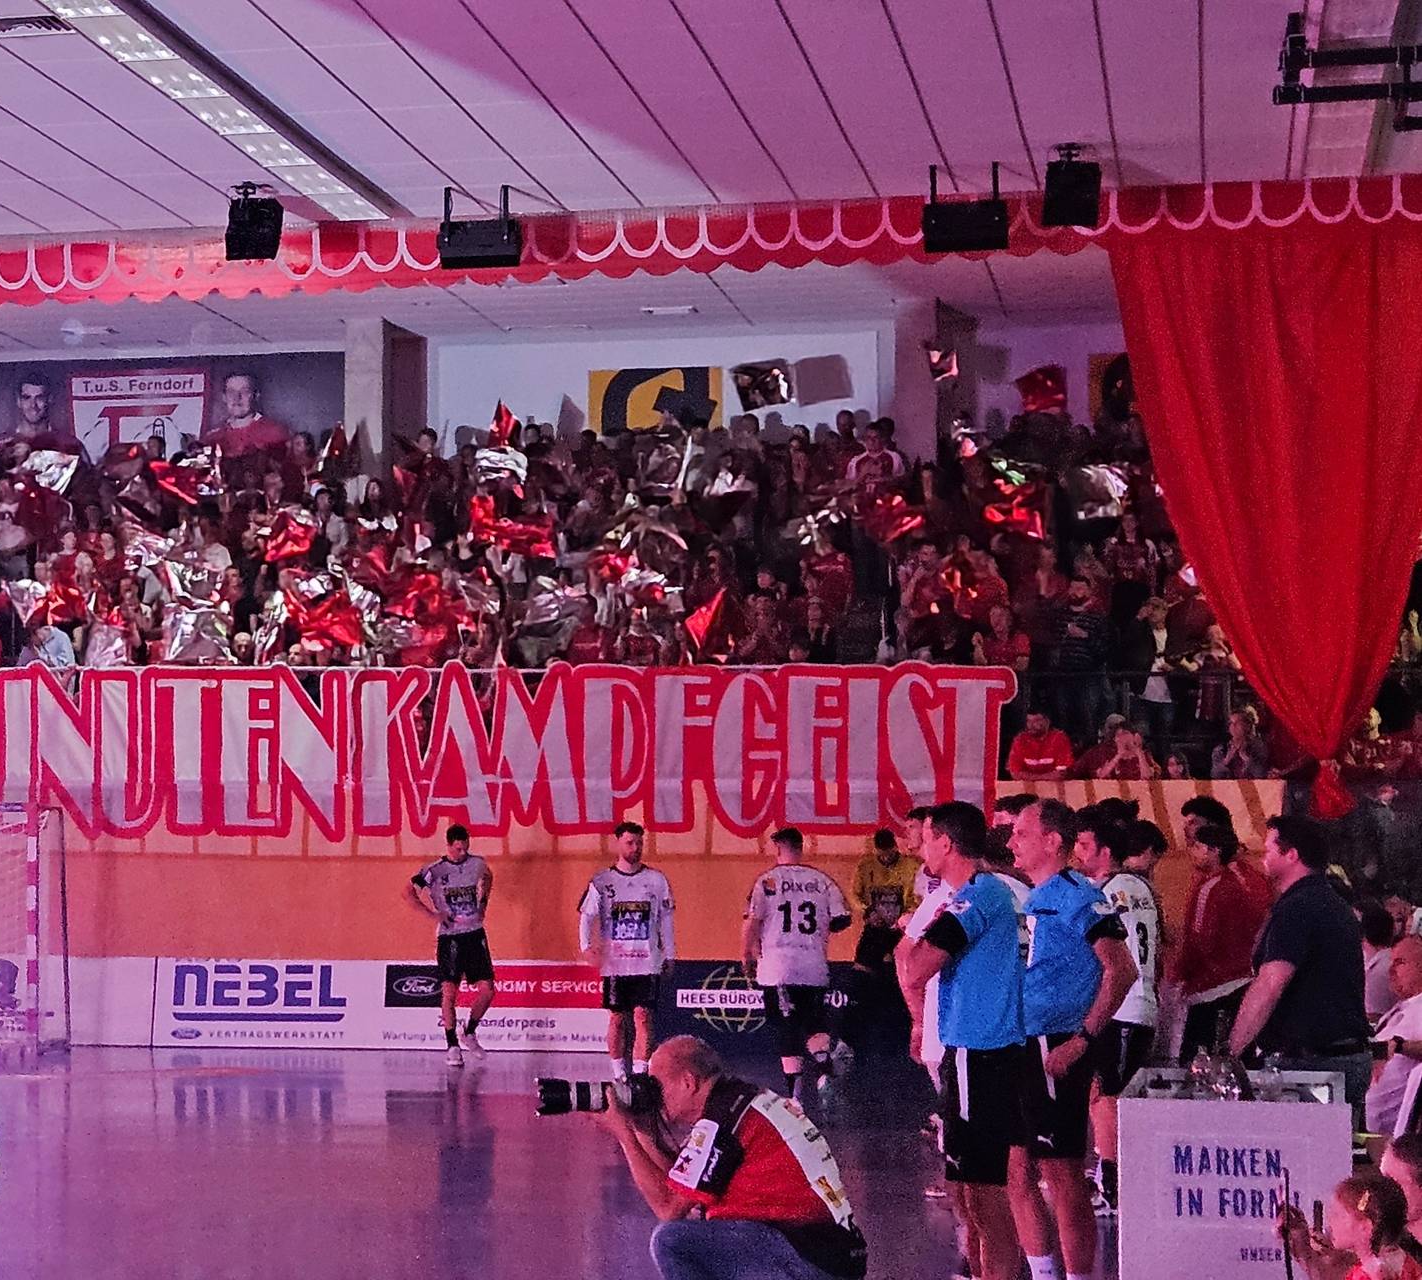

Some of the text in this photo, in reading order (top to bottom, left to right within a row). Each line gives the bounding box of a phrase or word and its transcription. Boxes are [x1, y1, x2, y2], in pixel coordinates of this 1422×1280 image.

[82, 377, 194, 393] T.u.S. Ferndorf
[351, 659, 1018, 839] KAMPFGEIST
[781, 880, 821, 895] pixel
[778, 900, 817, 935] 13
[172, 965, 347, 1007] NEBEL
[401, 978, 435, 994] Ford
[458, 980, 537, 993] ECNOMY
[680, 993, 716, 1005] HEES
[209, 1030, 345, 1040] VERTRAGSWERKSTATT
[382, 1031, 427, 1042] Wartung
[1174, 1145, 1281, 1177] MARKEN
[1176, 1186, 1203, 1217] IN
